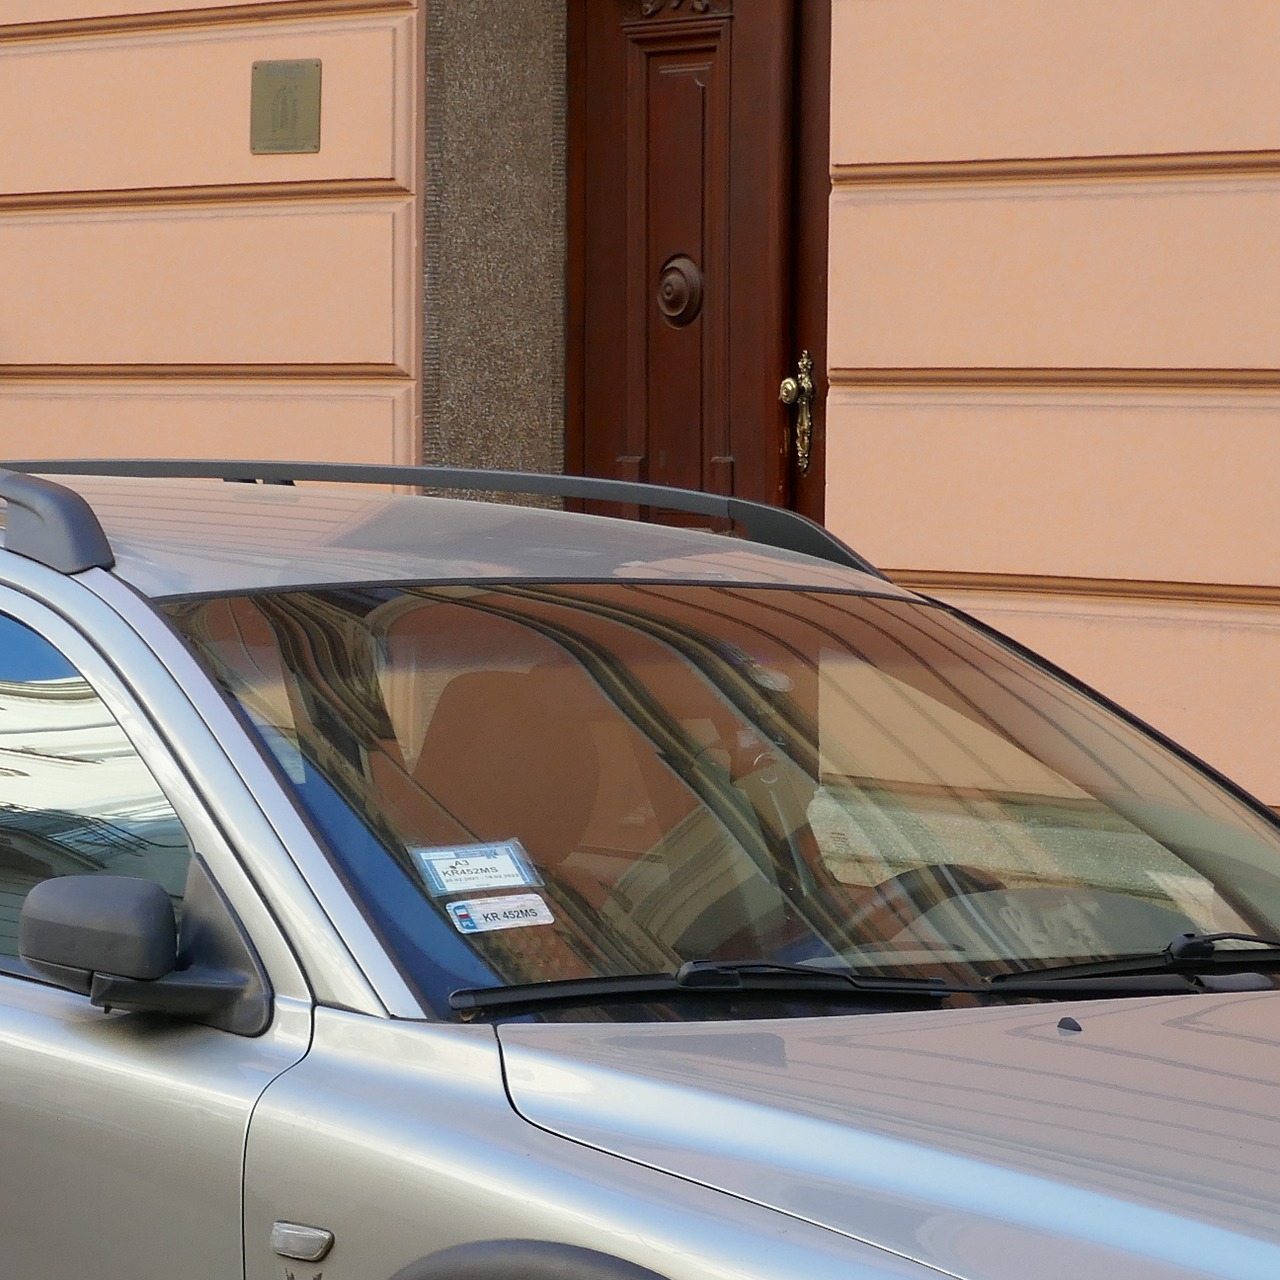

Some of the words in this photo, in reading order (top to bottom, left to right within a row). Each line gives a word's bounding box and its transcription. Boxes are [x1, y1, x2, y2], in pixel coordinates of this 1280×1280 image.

[441, 866, 499, 877] KR452MS
[482, 911, 501, 922] KR
[502, 908, 538, 920] 452MS
